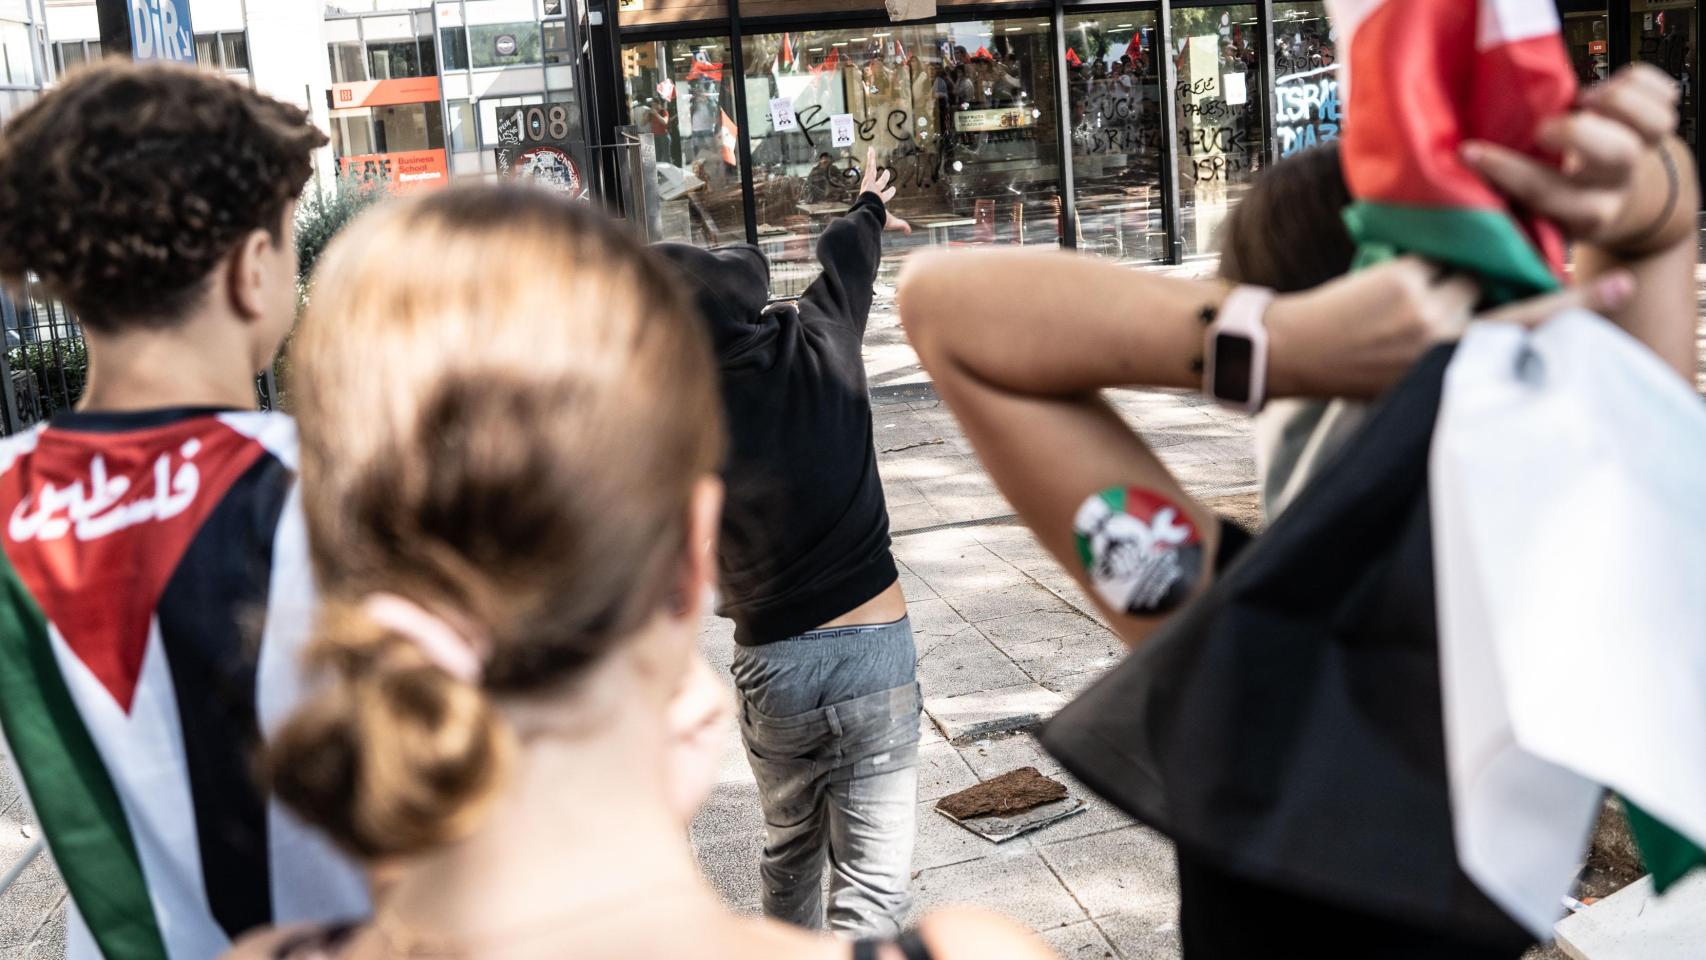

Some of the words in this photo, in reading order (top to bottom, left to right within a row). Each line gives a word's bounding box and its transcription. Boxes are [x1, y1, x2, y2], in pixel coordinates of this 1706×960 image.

[1175, 77, 1215, 101] FREE
[1182, 99, 1257, 118] PALESTIE
[510, 106, 568, 142] 108
[794, 104, 911, 147] Fee
[1179, 126, 1246, 157] FUCK
[398, 155, 435, 165] Business
[398, 164, 428, 174] School
[8, 438, 202, 542] فلسطين
